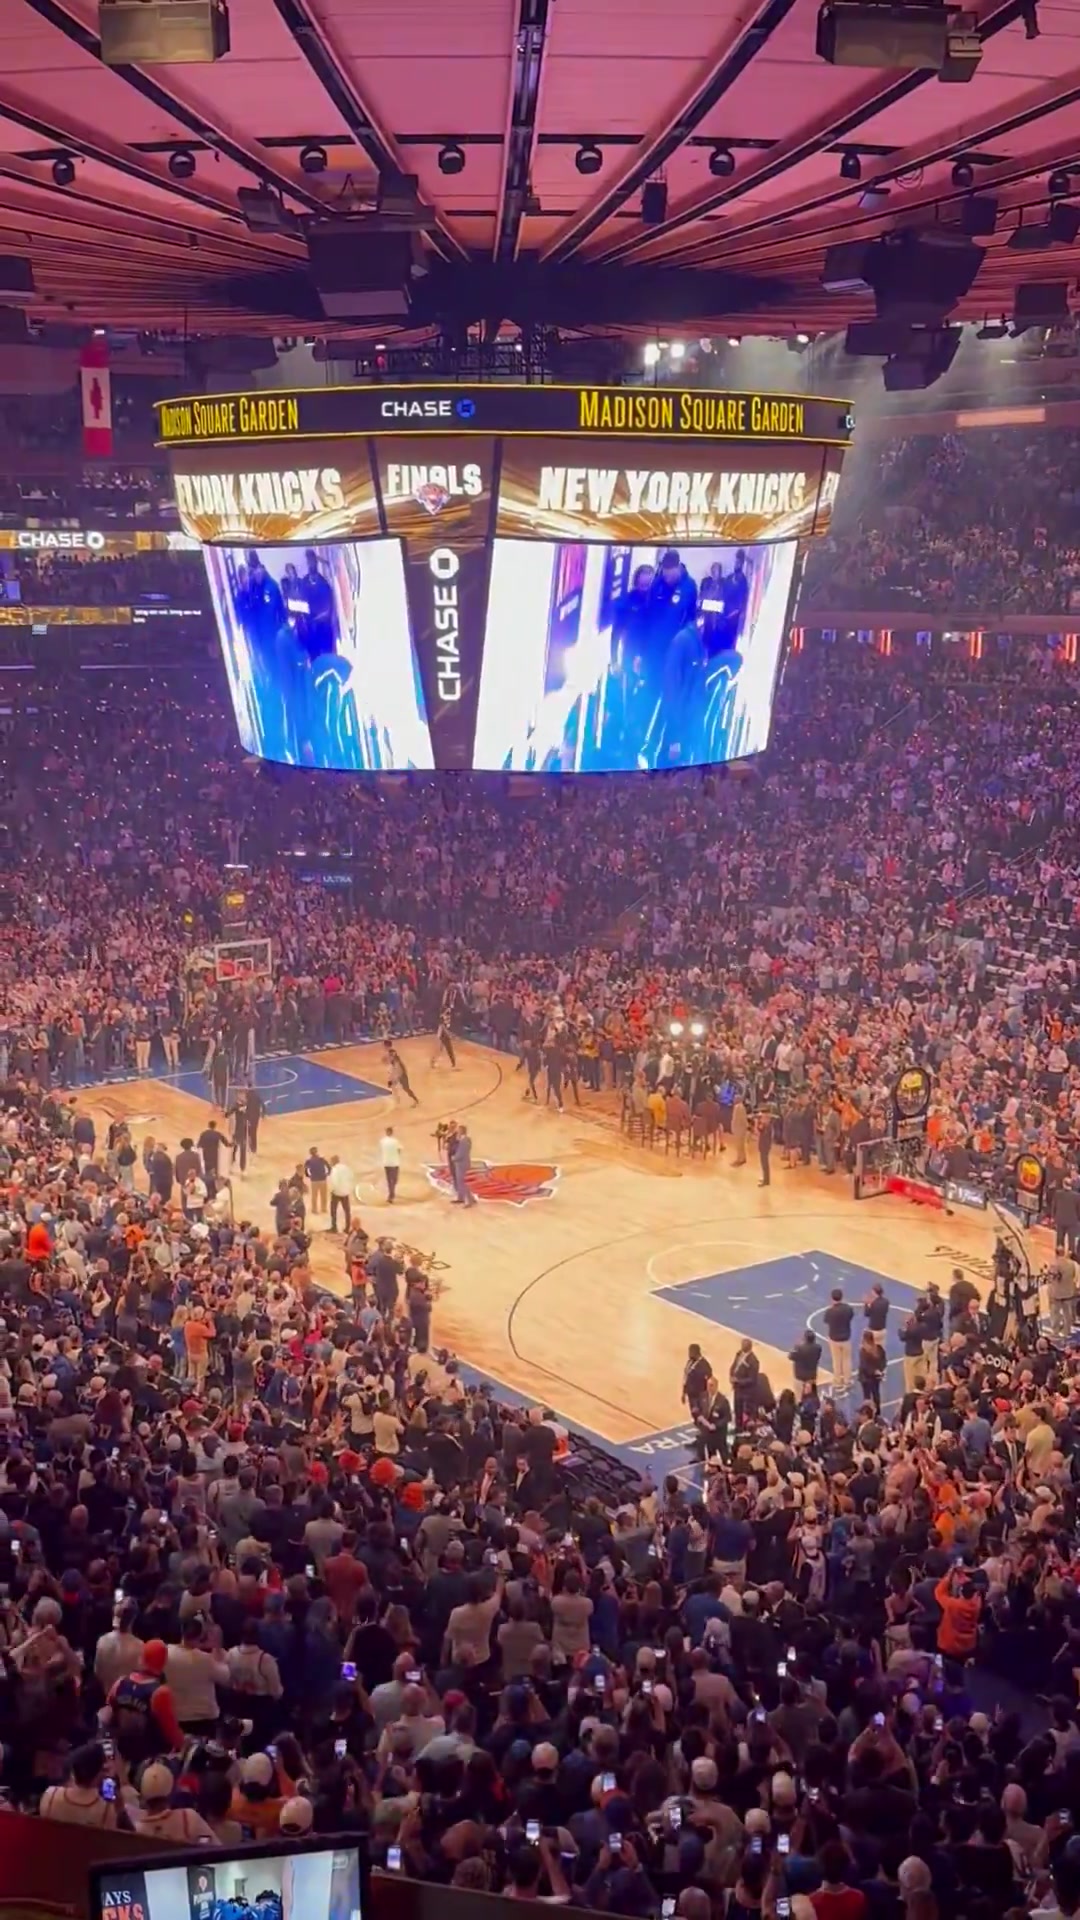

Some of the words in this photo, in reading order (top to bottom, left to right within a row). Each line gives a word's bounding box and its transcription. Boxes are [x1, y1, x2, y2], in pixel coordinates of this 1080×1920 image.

[193, 401, 237, 436] SQUARE
[239, 397, 299, 433] GARDEN
[381, 400, 452, 417] CHASE
[579, 391, 673, 429] MADISON
[680, 394, 746, 432] SQUARE
[751, 396, 805, 434] GARDEN
[190, 473, 241, 516] YORK
[239, 467, 347, 516] KNICKS
[387, 463, 483, 496] FINALS
[538, 466, 618, 512] NEW
[626, 469, 711, 515] YORK
[717, 471, 807, 516] KNICKS
[18, 532, 84, 548] CHASE
[433, 585, 461, 700] CHASE
[101, 1890, 132, 1907] AYS
